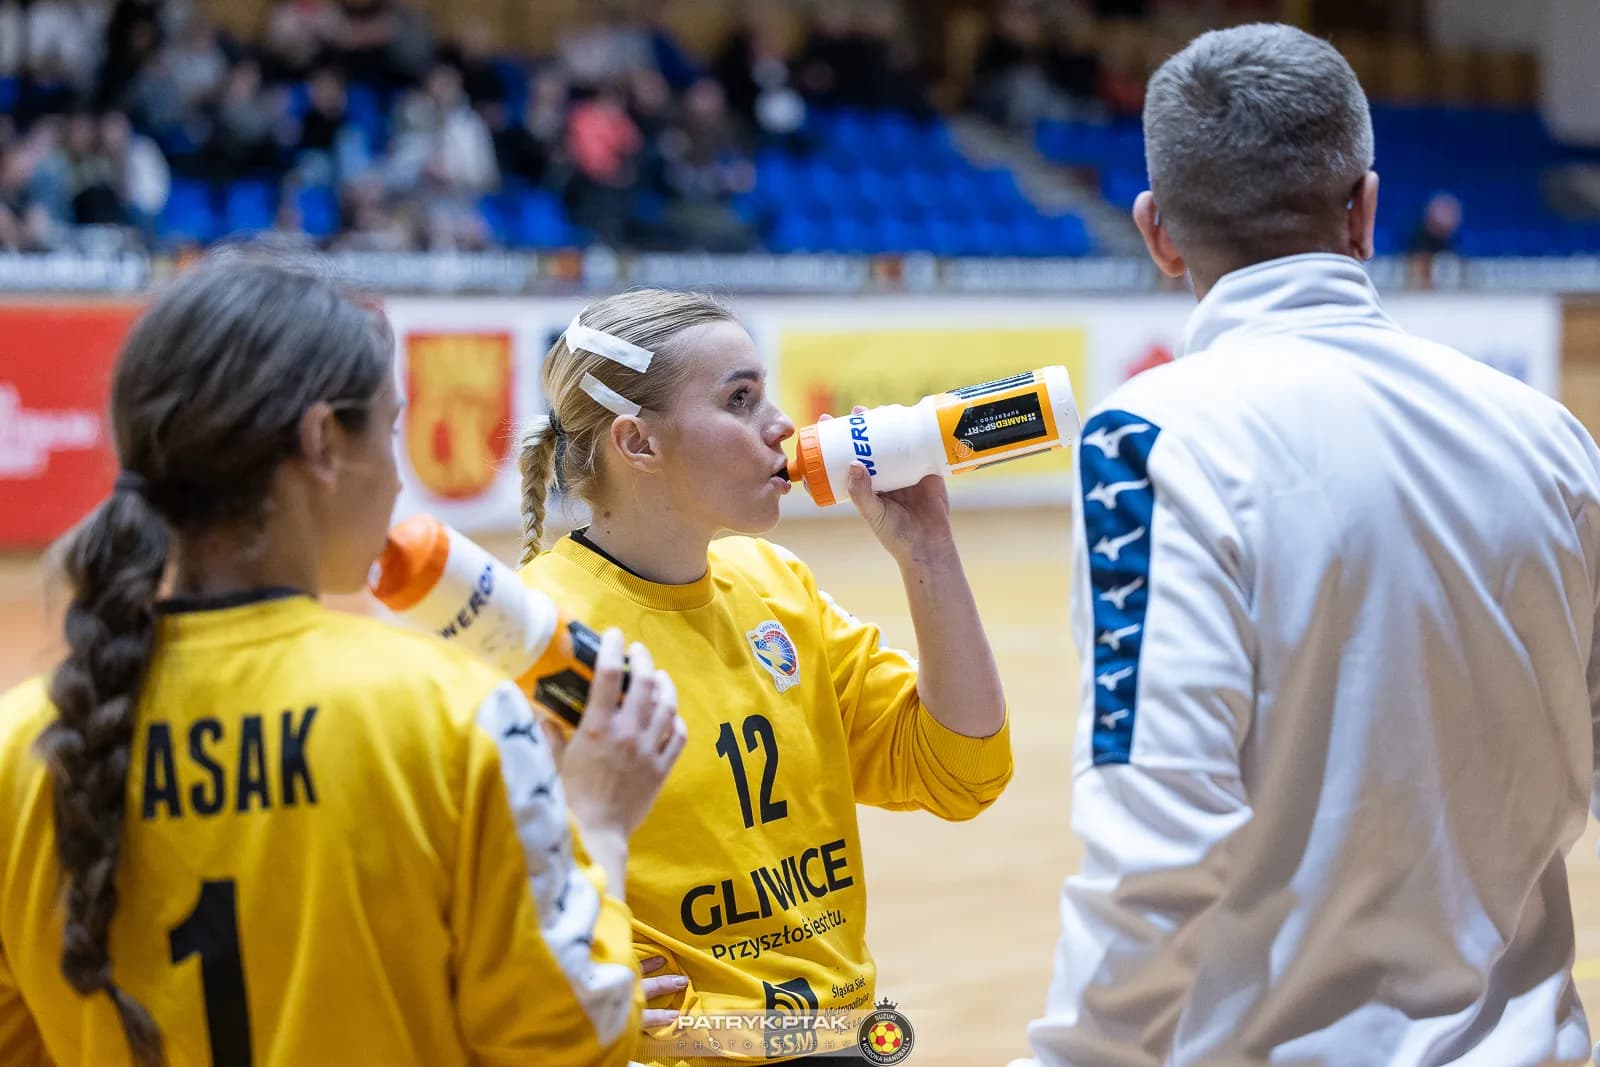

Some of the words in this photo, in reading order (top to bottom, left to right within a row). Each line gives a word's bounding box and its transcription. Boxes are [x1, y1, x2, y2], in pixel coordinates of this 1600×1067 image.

[848, 411, 878, 477] WERO
[967, 414, 1028, 436] NAMEDSPORT
[439, 564, 494, 640] WERO
[715, 714, 788, 829] 12
[680, 839, 854, 936] GLIWICE
[168, 877, 254, 1067] 1
[711, 918, 813, 961] Przyszłoś
[769, 1029, 816, 1057] SSM
